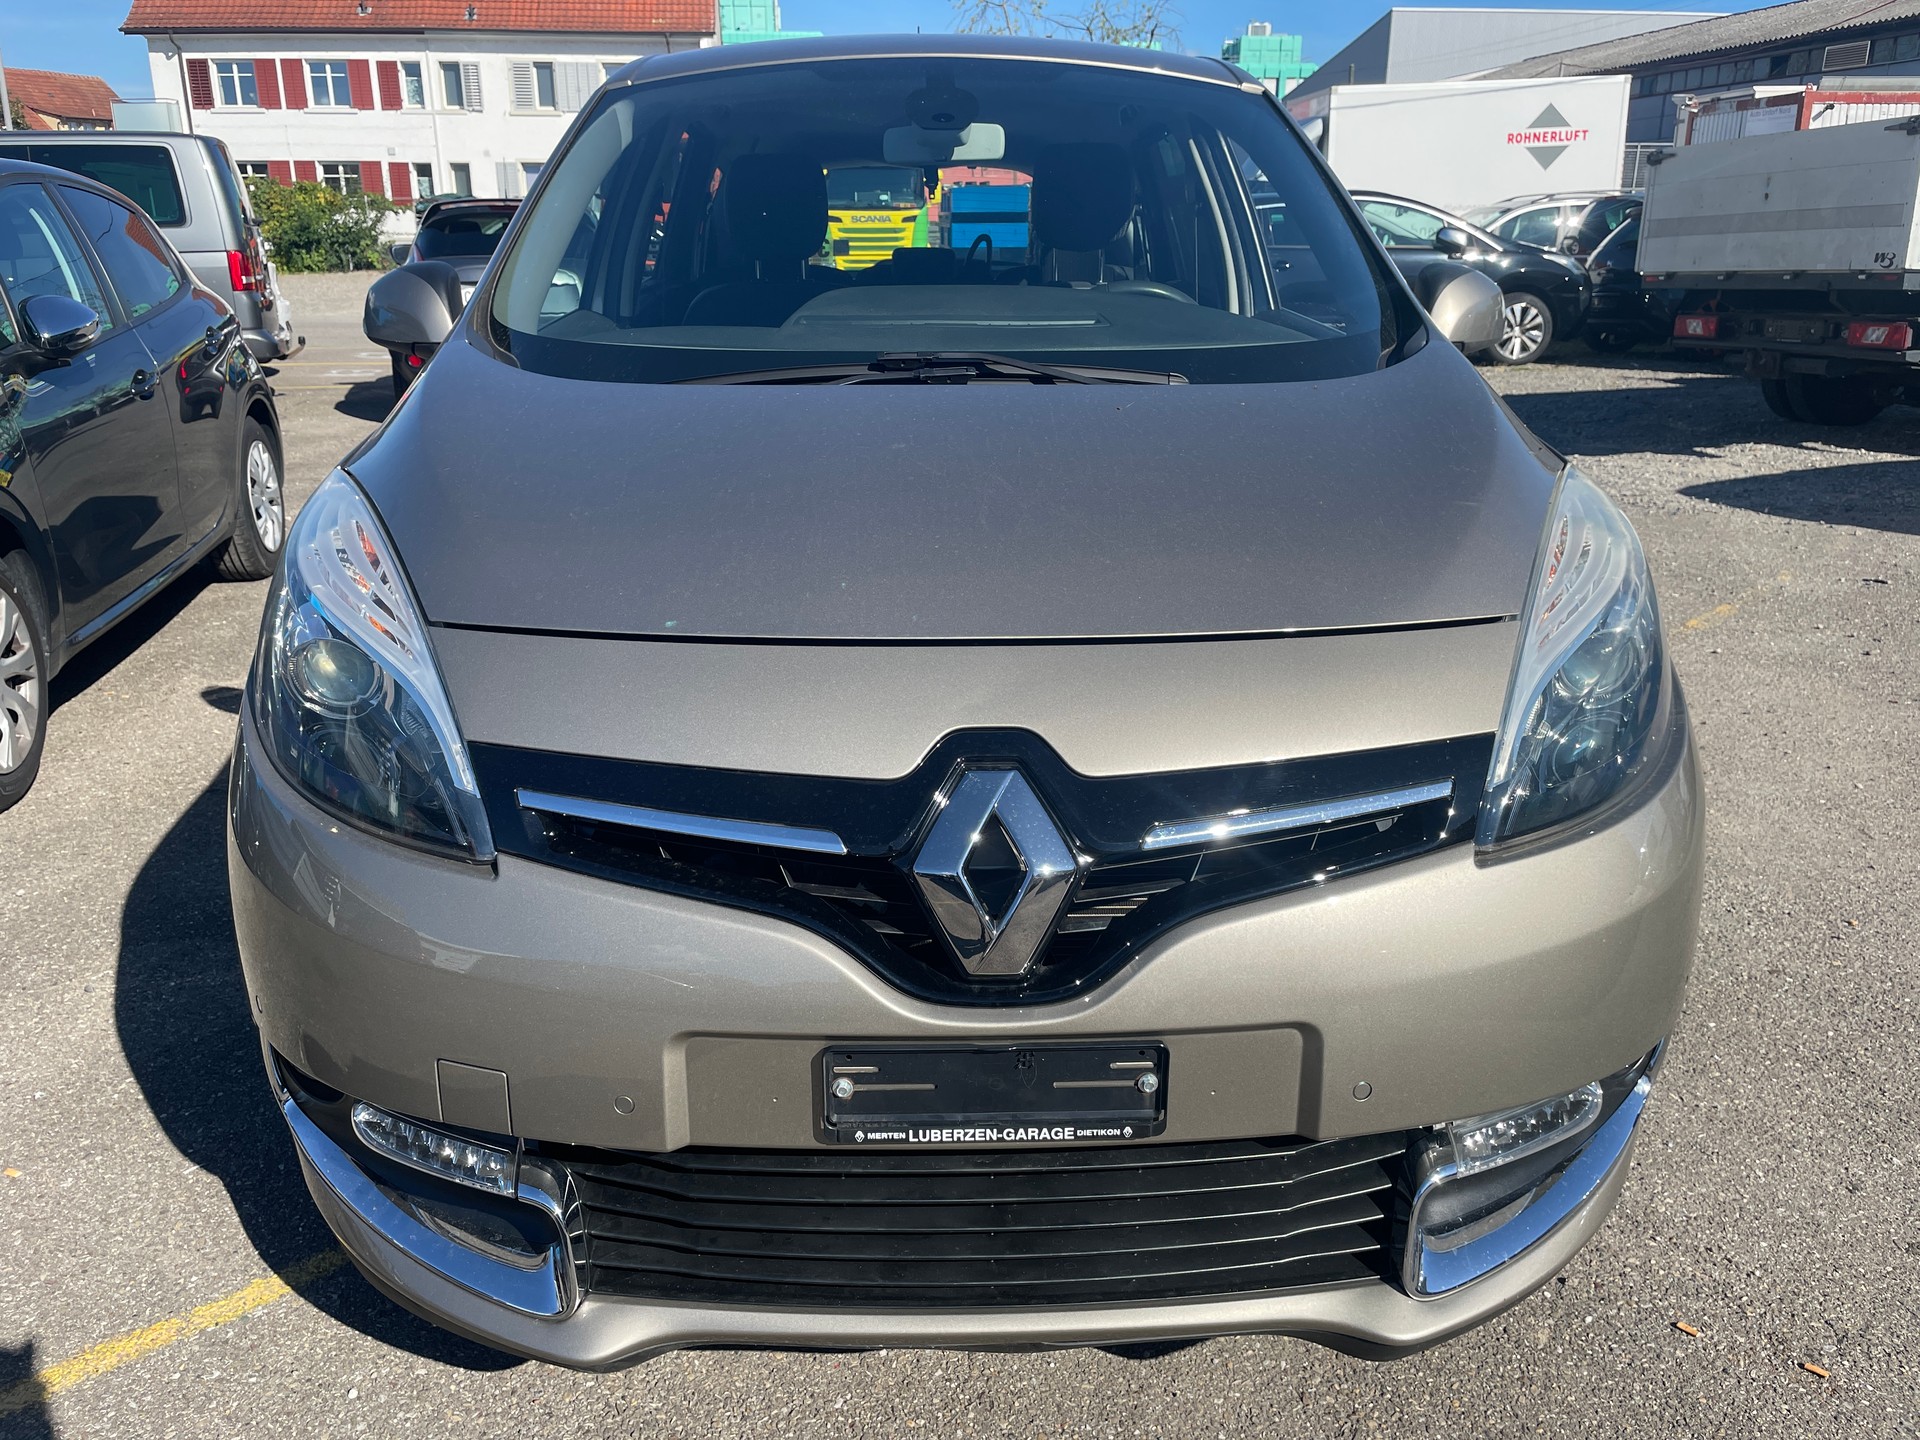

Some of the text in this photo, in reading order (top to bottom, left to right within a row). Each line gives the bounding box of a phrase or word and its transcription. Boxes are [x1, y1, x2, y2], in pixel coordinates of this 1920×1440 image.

[1507, 129, 1589, 144] ROHNERLUFT
[851, 215, 891, 223] SCANIA
[867, 1127, 1120, 1142] MERTEN LUBERZEN-GARAGE DIETIKON
